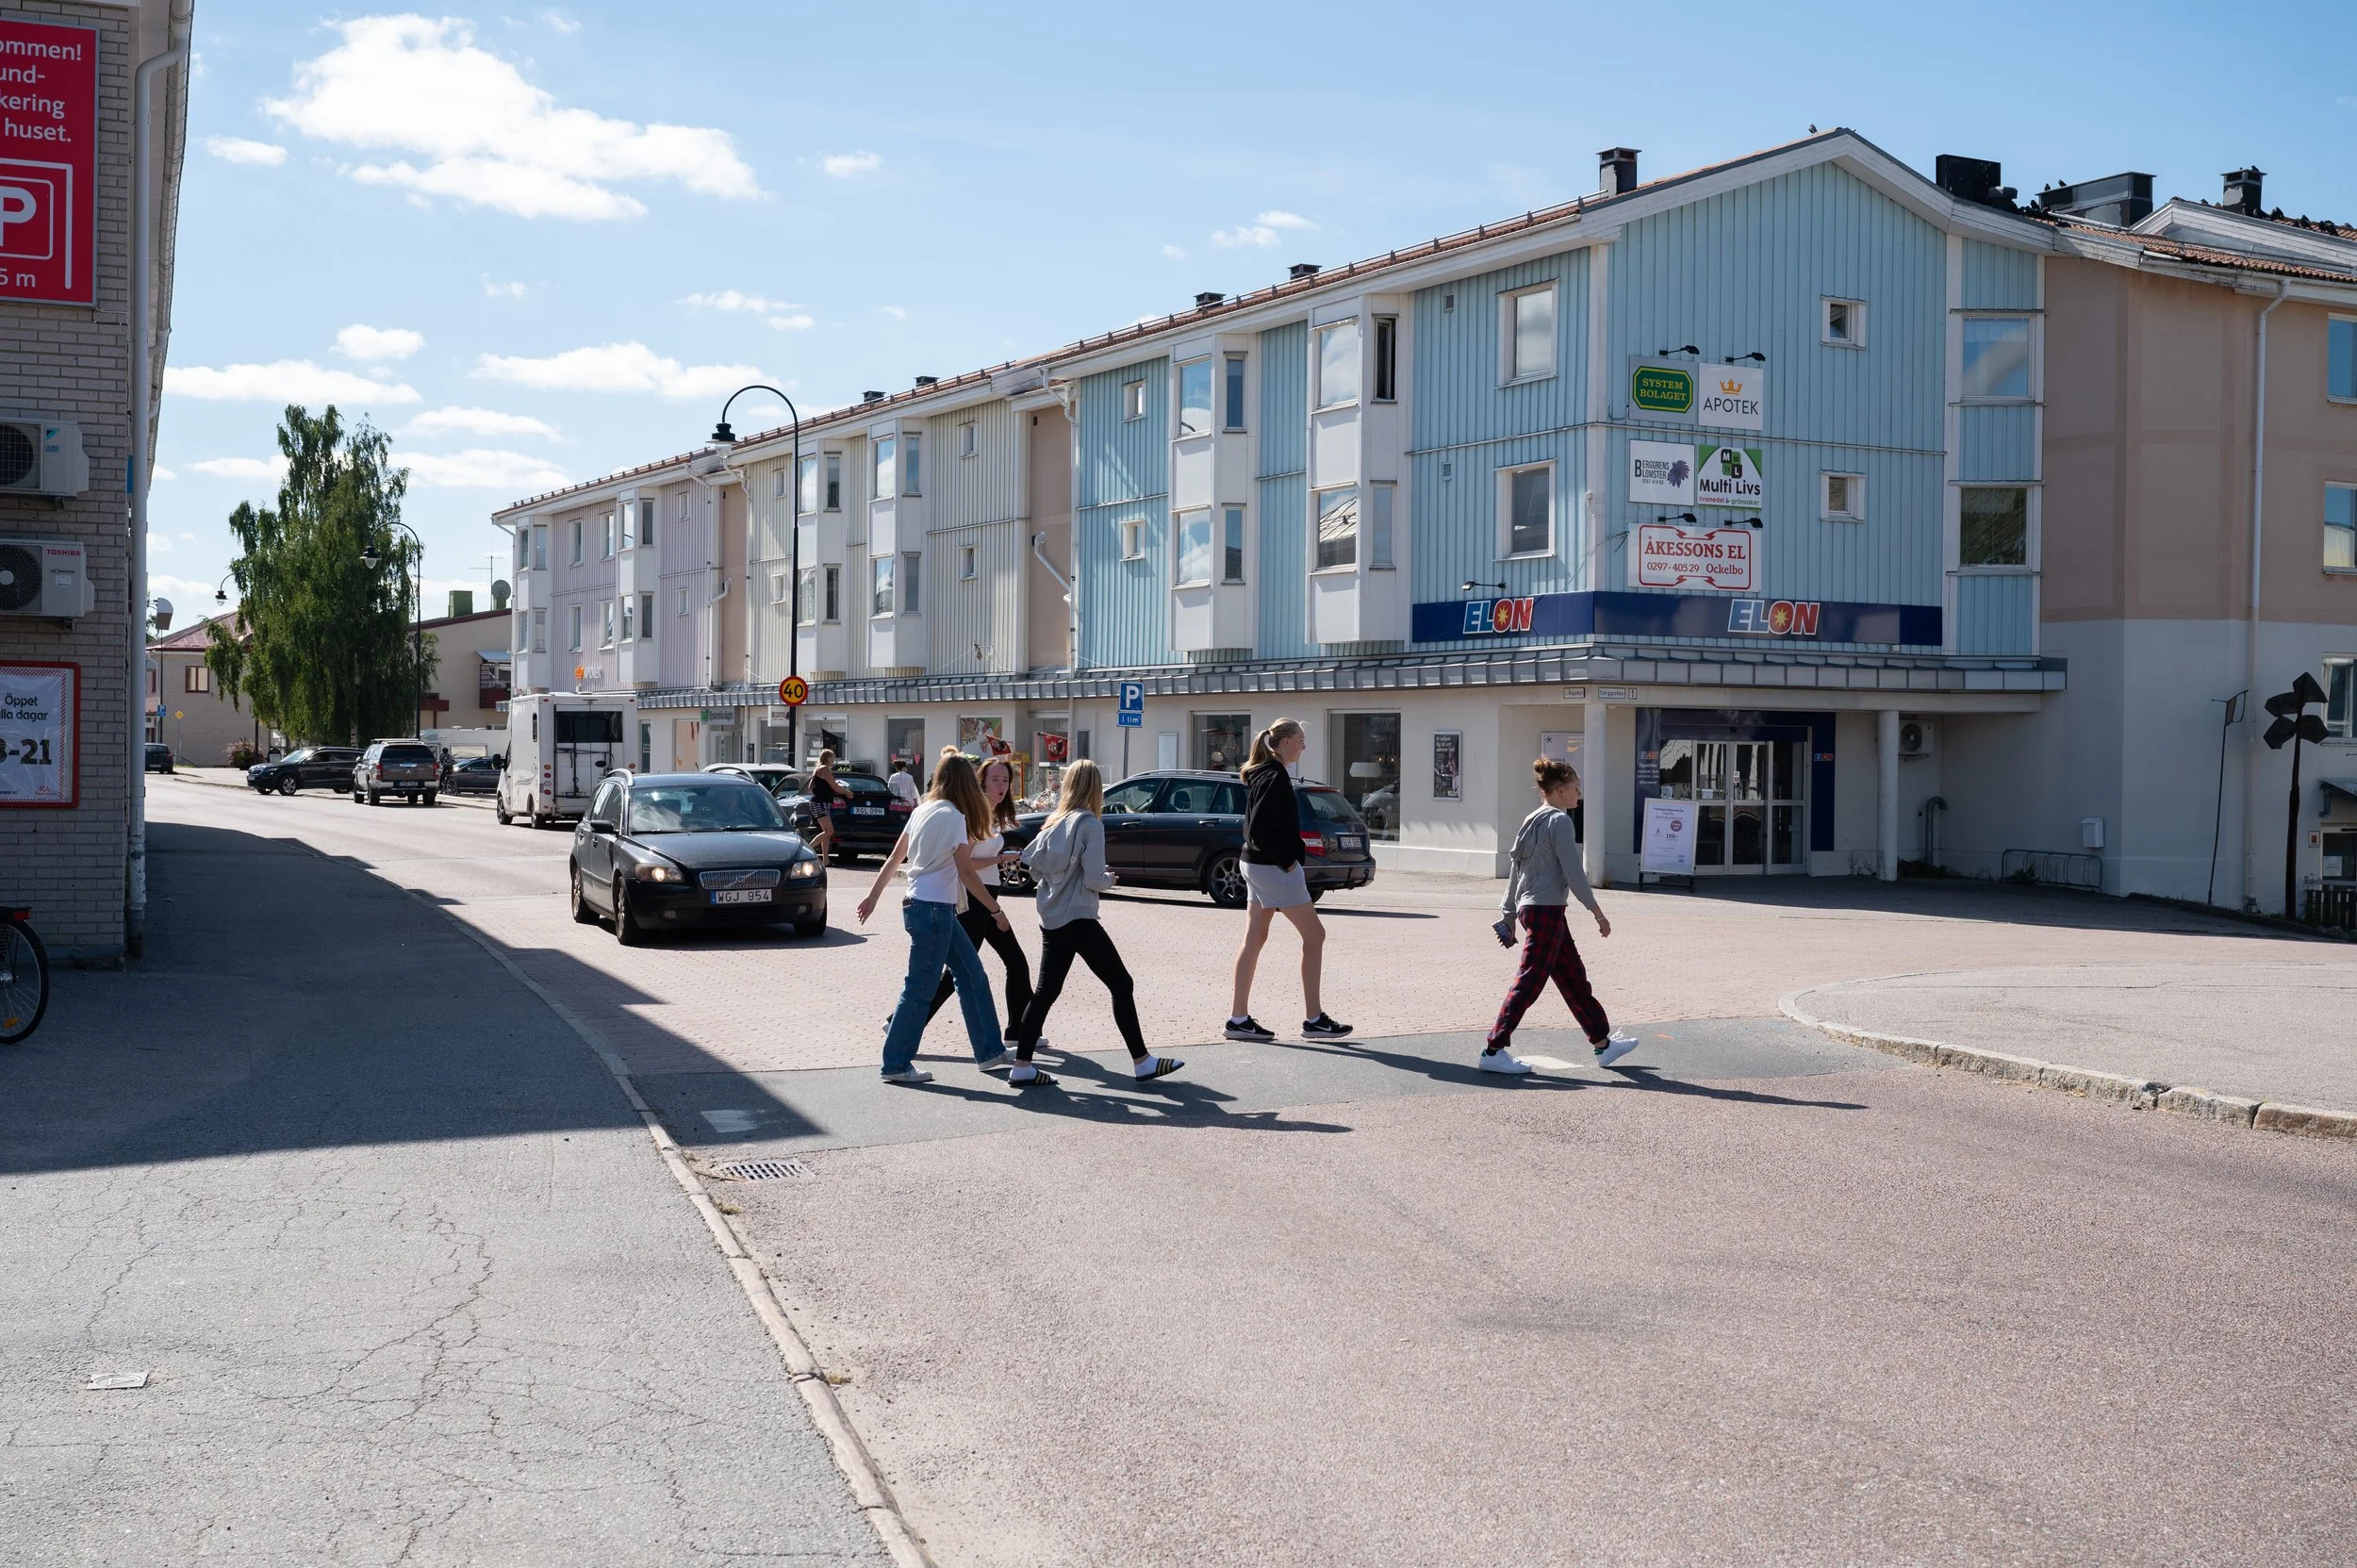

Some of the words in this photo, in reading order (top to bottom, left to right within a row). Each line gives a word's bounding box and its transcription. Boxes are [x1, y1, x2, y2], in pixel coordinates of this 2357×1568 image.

[5, 117, 72, 142] huset.
[0, 186, 37, 247] P
[16, 272, 36, 288] m
[1642, 378, 1684, 389] SYSTEM
[1640, 388, 1687, 401] BOLAGET
[1703, 397, 1759, 415] APOTEK
[1722, 453, 1730, 461] M
[1700, 479, 1732, 493] Multi
[1736, 480, 1760, 496] Livs
[1644, 536, 1723, 559] ÅKESSONS
[1727, 546, 1746, 560] EL
[1706, 563, 1743, 575] Ockelbo
[1462, 597, 1535, 635] ELON
[1727, 599, 1821, 635] ELON
[783, 684, 804, 699] 40
[1125, 685, 1140, 709] P
[5, 693, 38, 708] Öppet
[16, 709, 48, 722] dagar
[1639, 751, 1659, 759] ELON
[717, 892, 740, 902] WGJ
[748, 890, 769, 901] 954
